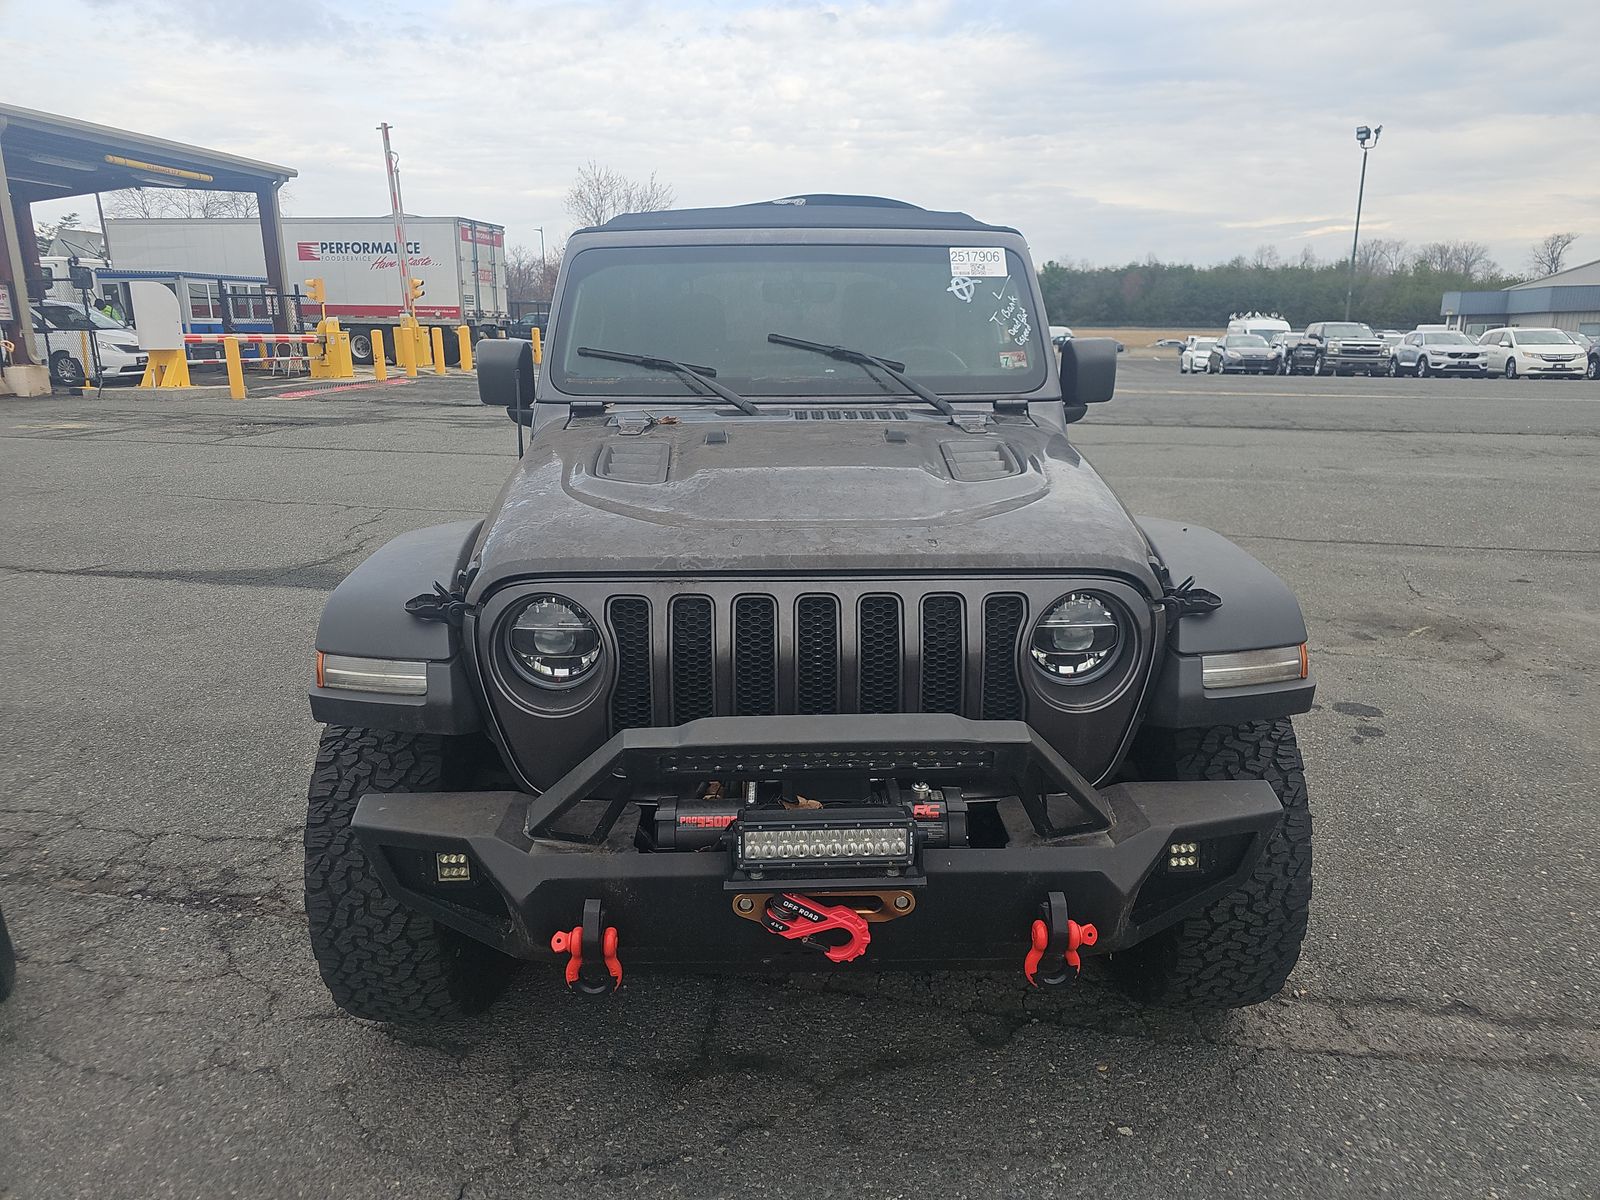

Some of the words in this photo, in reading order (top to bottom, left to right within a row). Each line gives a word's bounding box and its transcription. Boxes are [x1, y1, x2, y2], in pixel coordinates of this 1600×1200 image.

[950, 251, 1000, 262] 2517906
[371, 256, 398, 270] Have
[1002, 356, 1009, 366] 7
[913, 804, 940, 816] RC
[782, 900, 799, 911] OFF
[798, 908, 820, 922] ROAD
